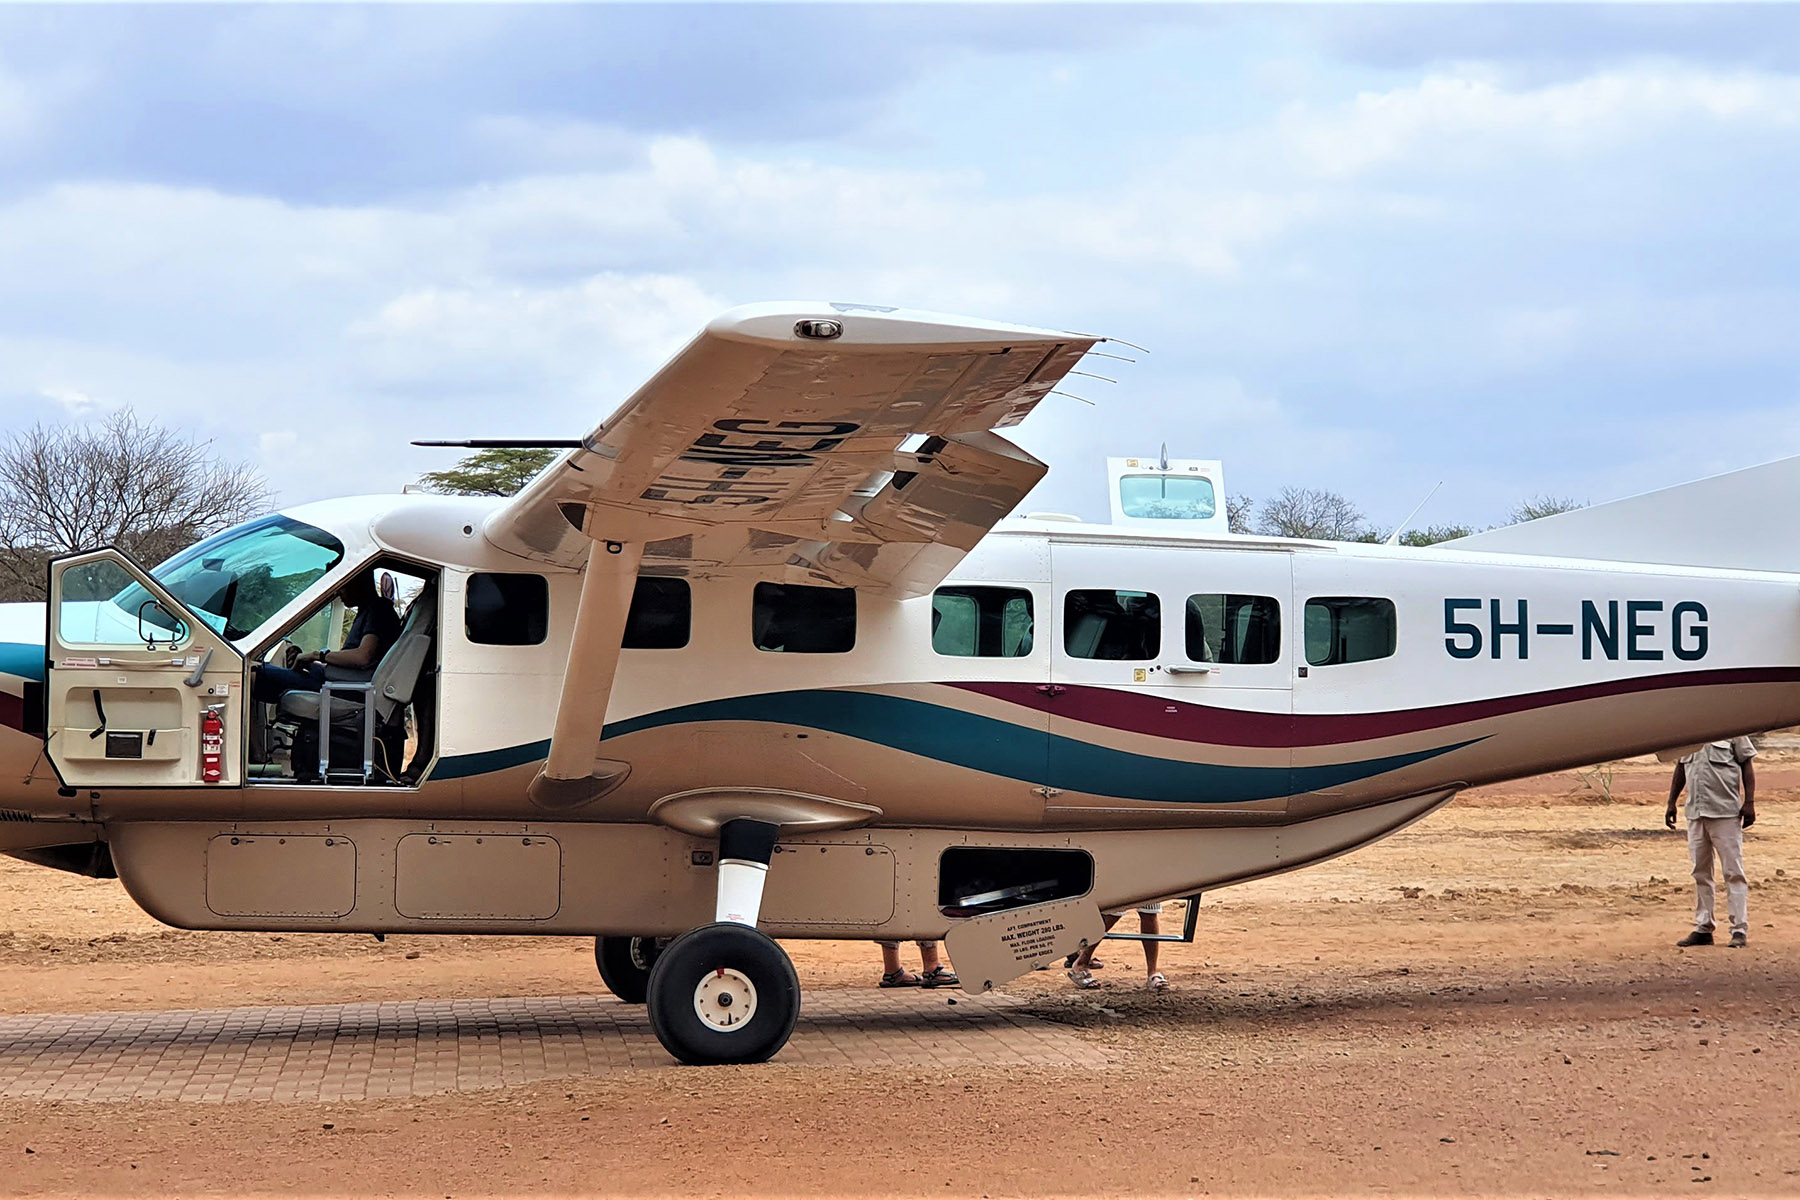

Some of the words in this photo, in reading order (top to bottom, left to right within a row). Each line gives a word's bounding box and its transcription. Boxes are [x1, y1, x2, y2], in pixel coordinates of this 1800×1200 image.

[640, 419, 861, 505] 5H-NEG
[1444, 598, 1709, 661] 5H-NEG
[1018, 918, 1052, 930] COMPARTMENT
[1017, 928, 1040, 938] WEIGHT
[1036, 934, 1056, 942] LOADING
